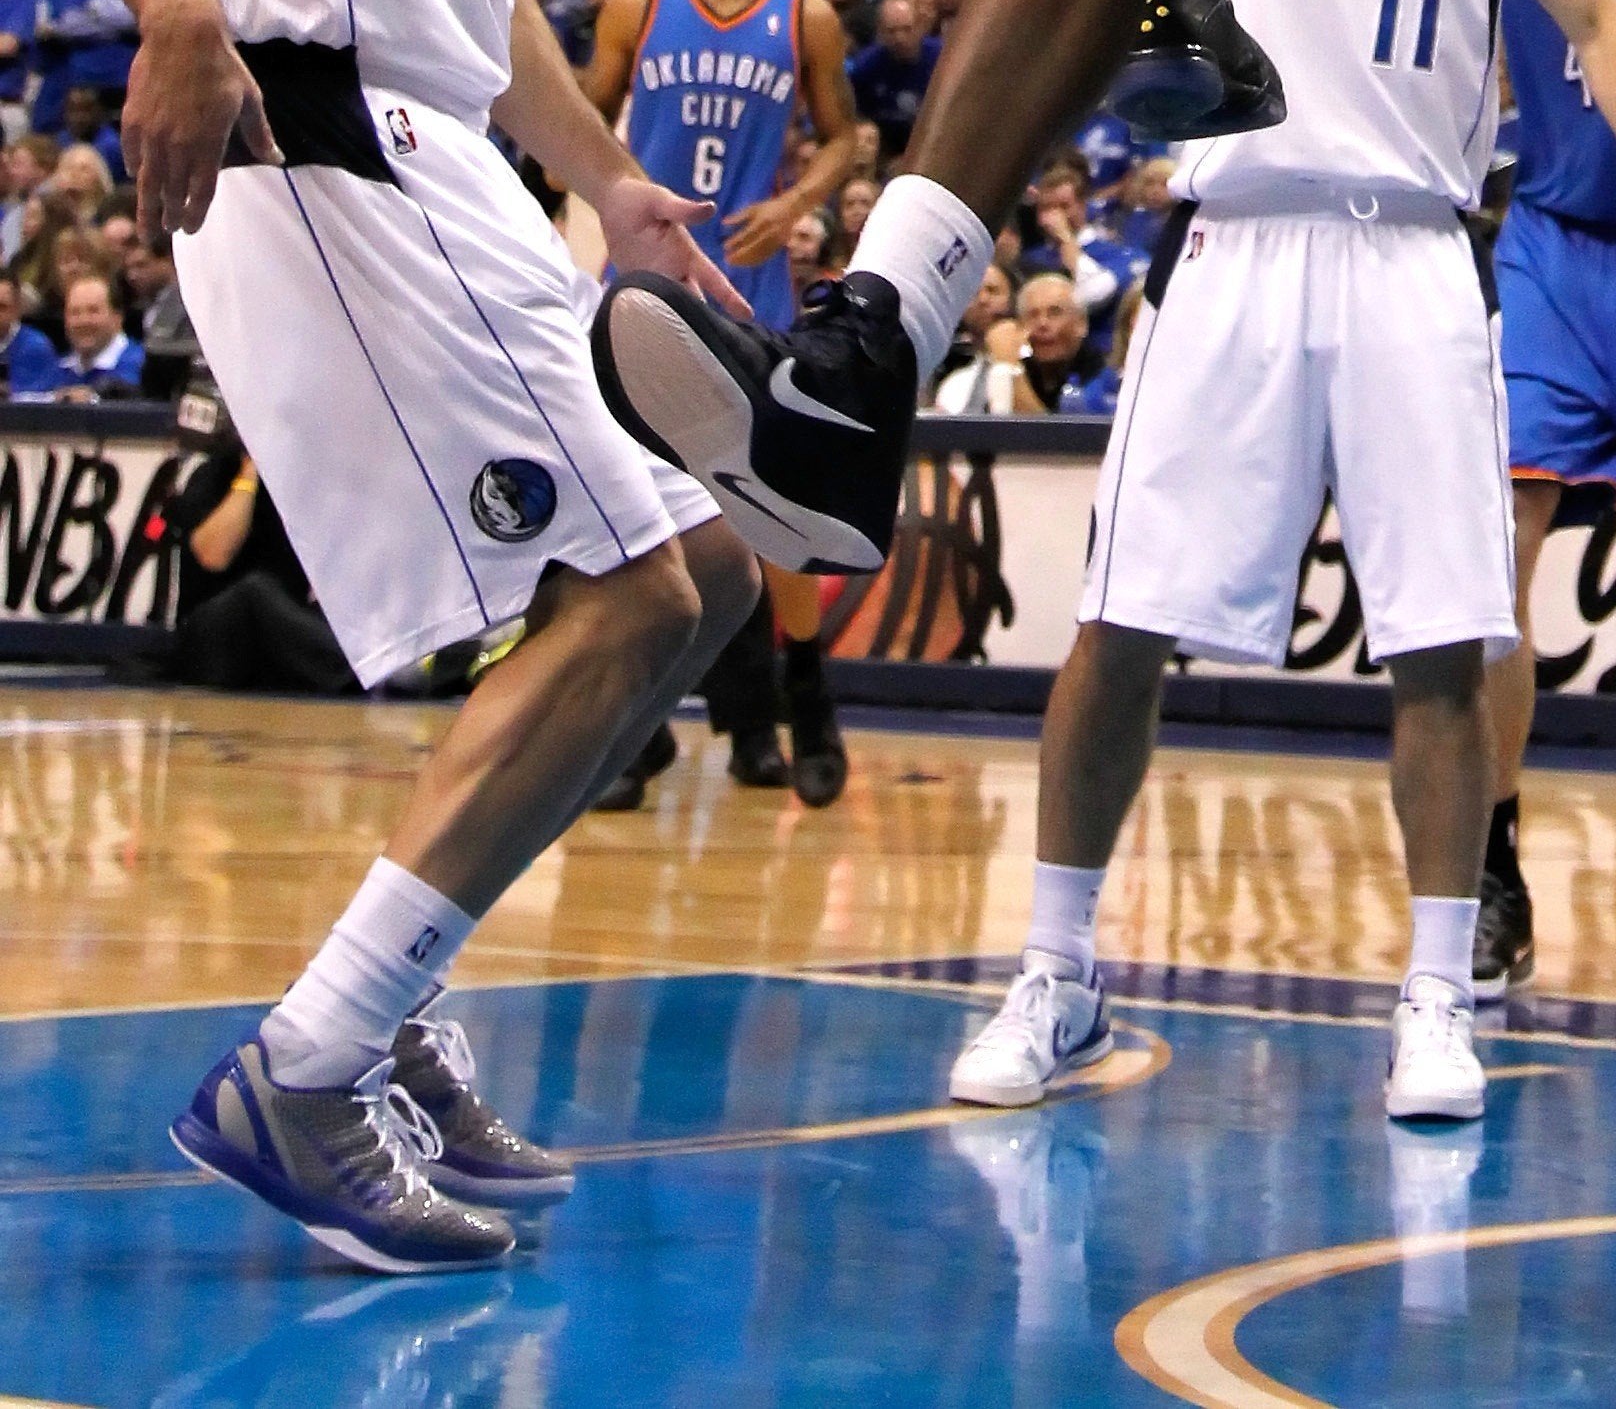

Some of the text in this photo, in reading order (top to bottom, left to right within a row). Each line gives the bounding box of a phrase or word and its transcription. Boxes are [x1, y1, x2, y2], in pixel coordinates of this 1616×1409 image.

[640, 49, 795, 104] OKLAHOMA
[681, 90, 746, 130] CITY
[692, 134, 727, 195] 6
